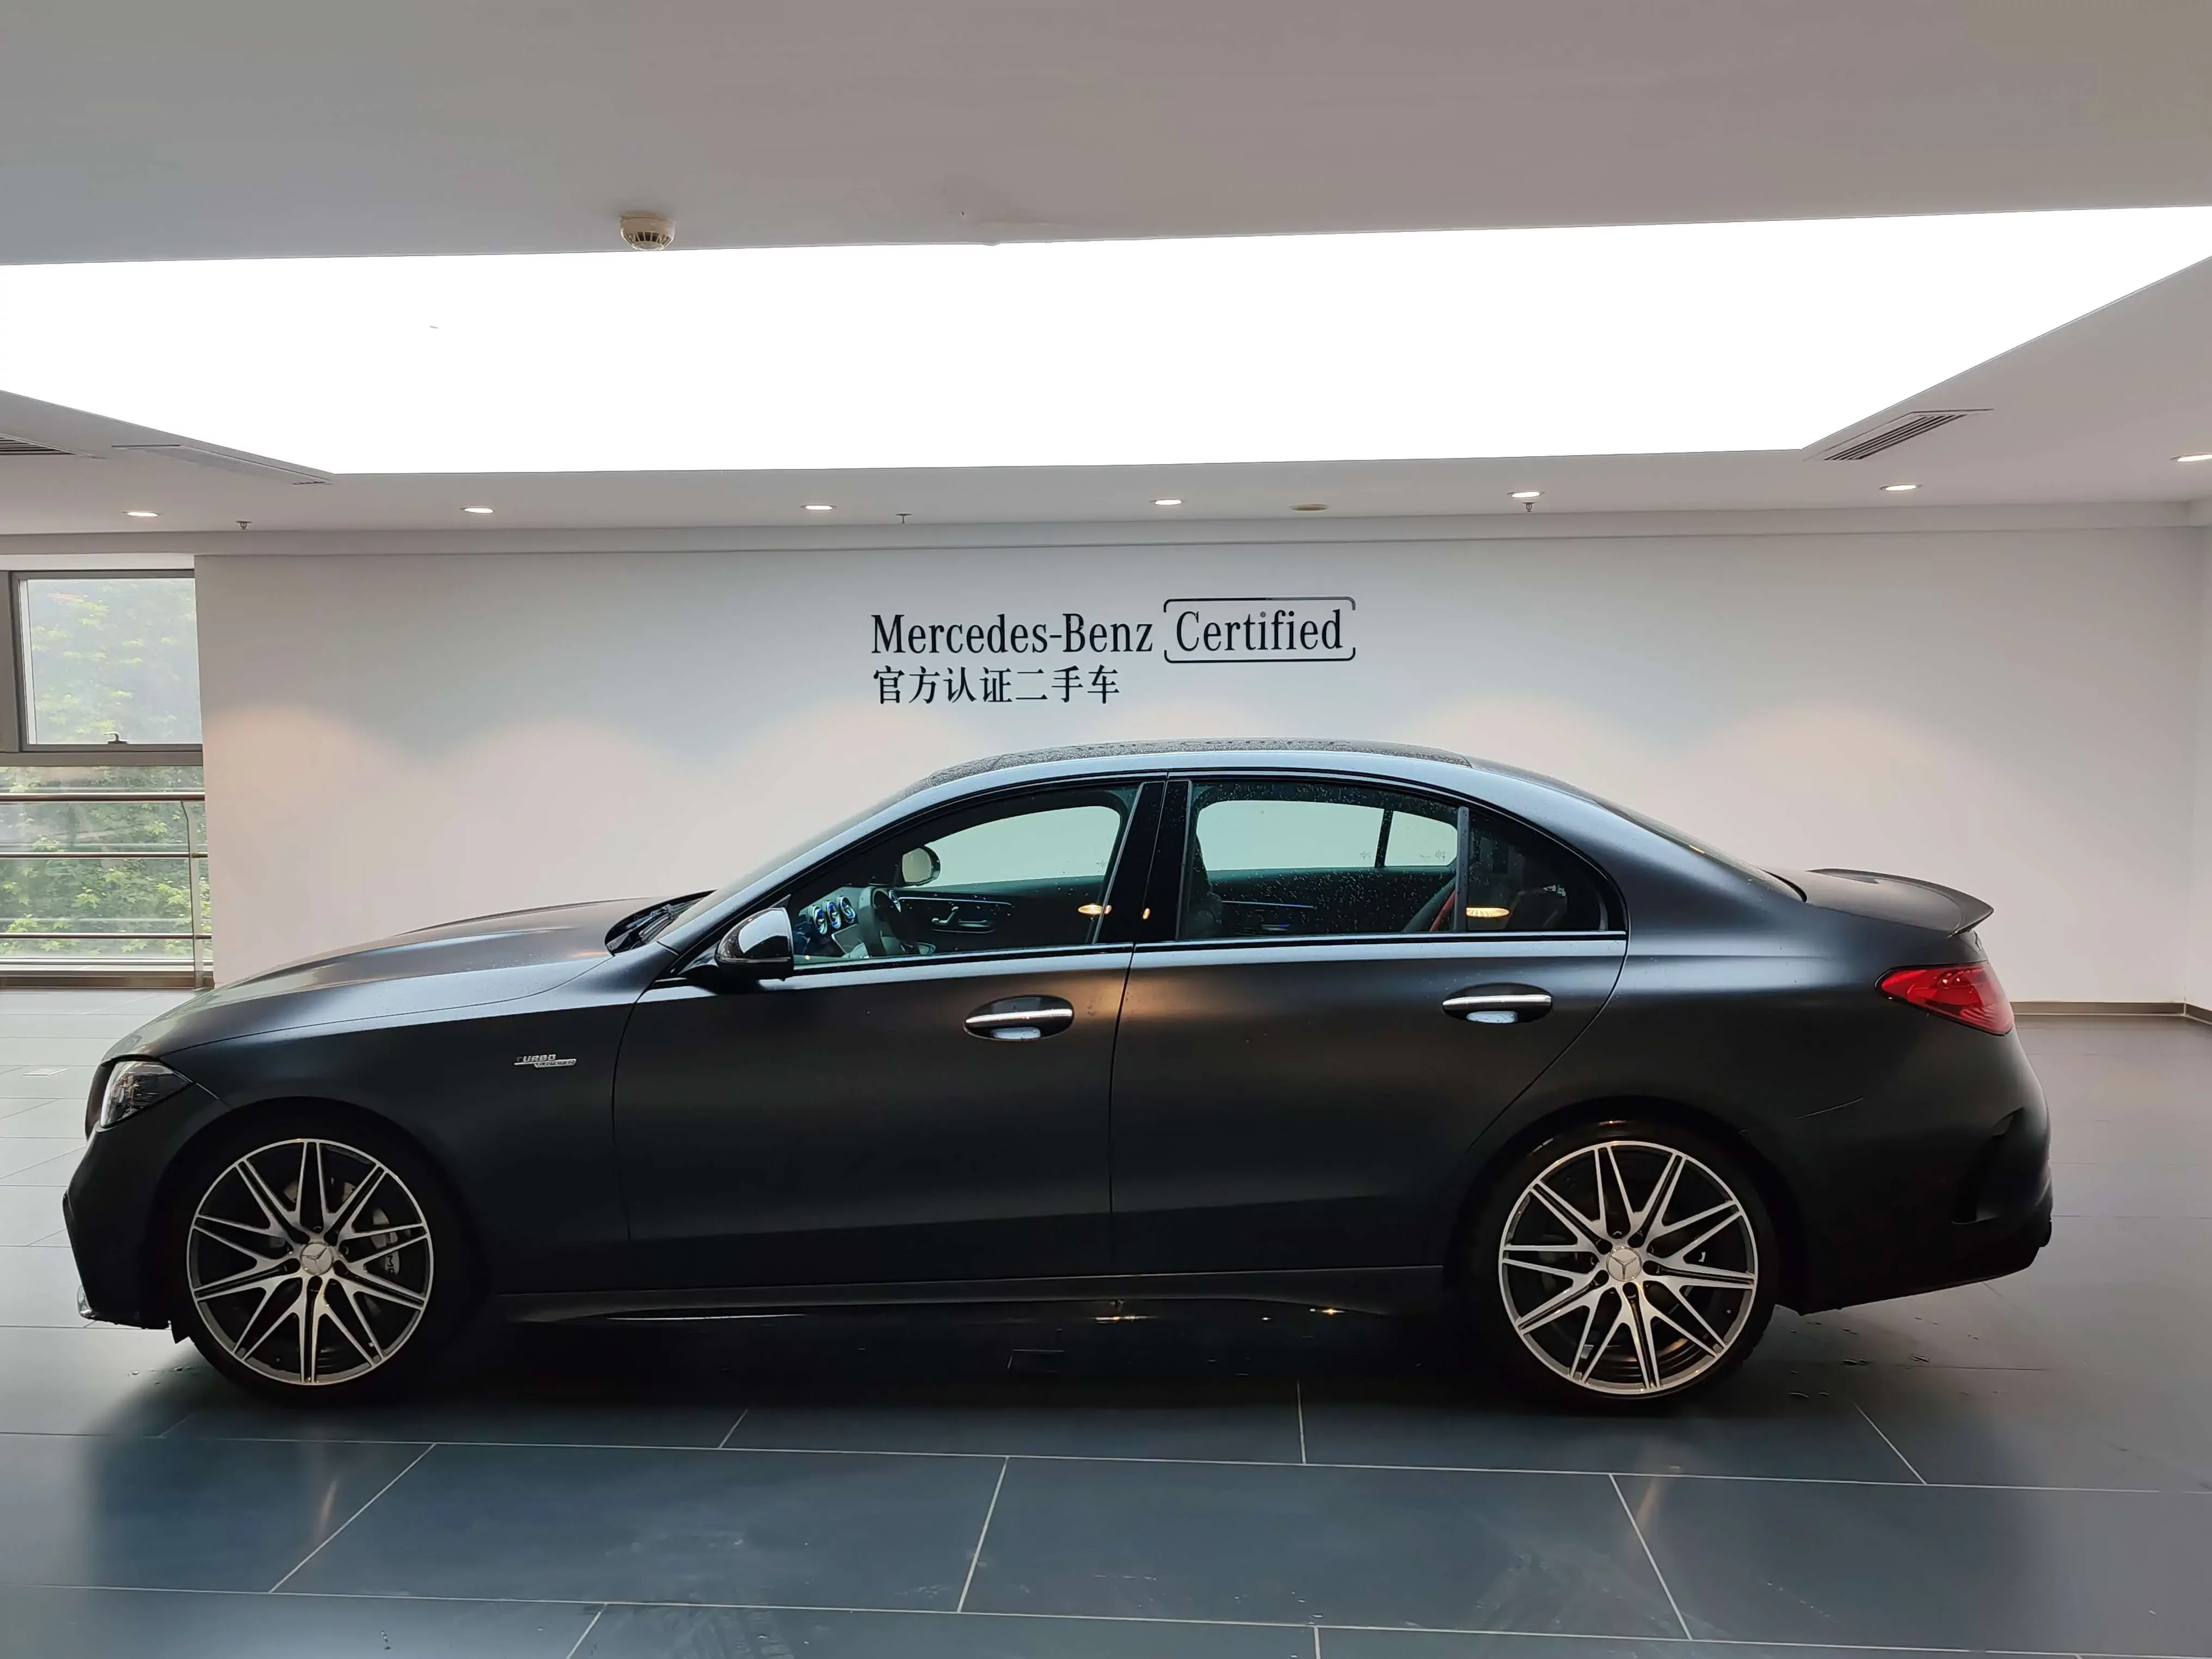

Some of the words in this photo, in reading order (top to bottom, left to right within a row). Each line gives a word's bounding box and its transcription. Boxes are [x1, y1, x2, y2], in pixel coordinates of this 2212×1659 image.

[870, 612, 1153, 654] Mercedes-Benz
[1176, 609, 1343, 652] Certified
[872, 664, 1120, 704] 官方认证二手车
